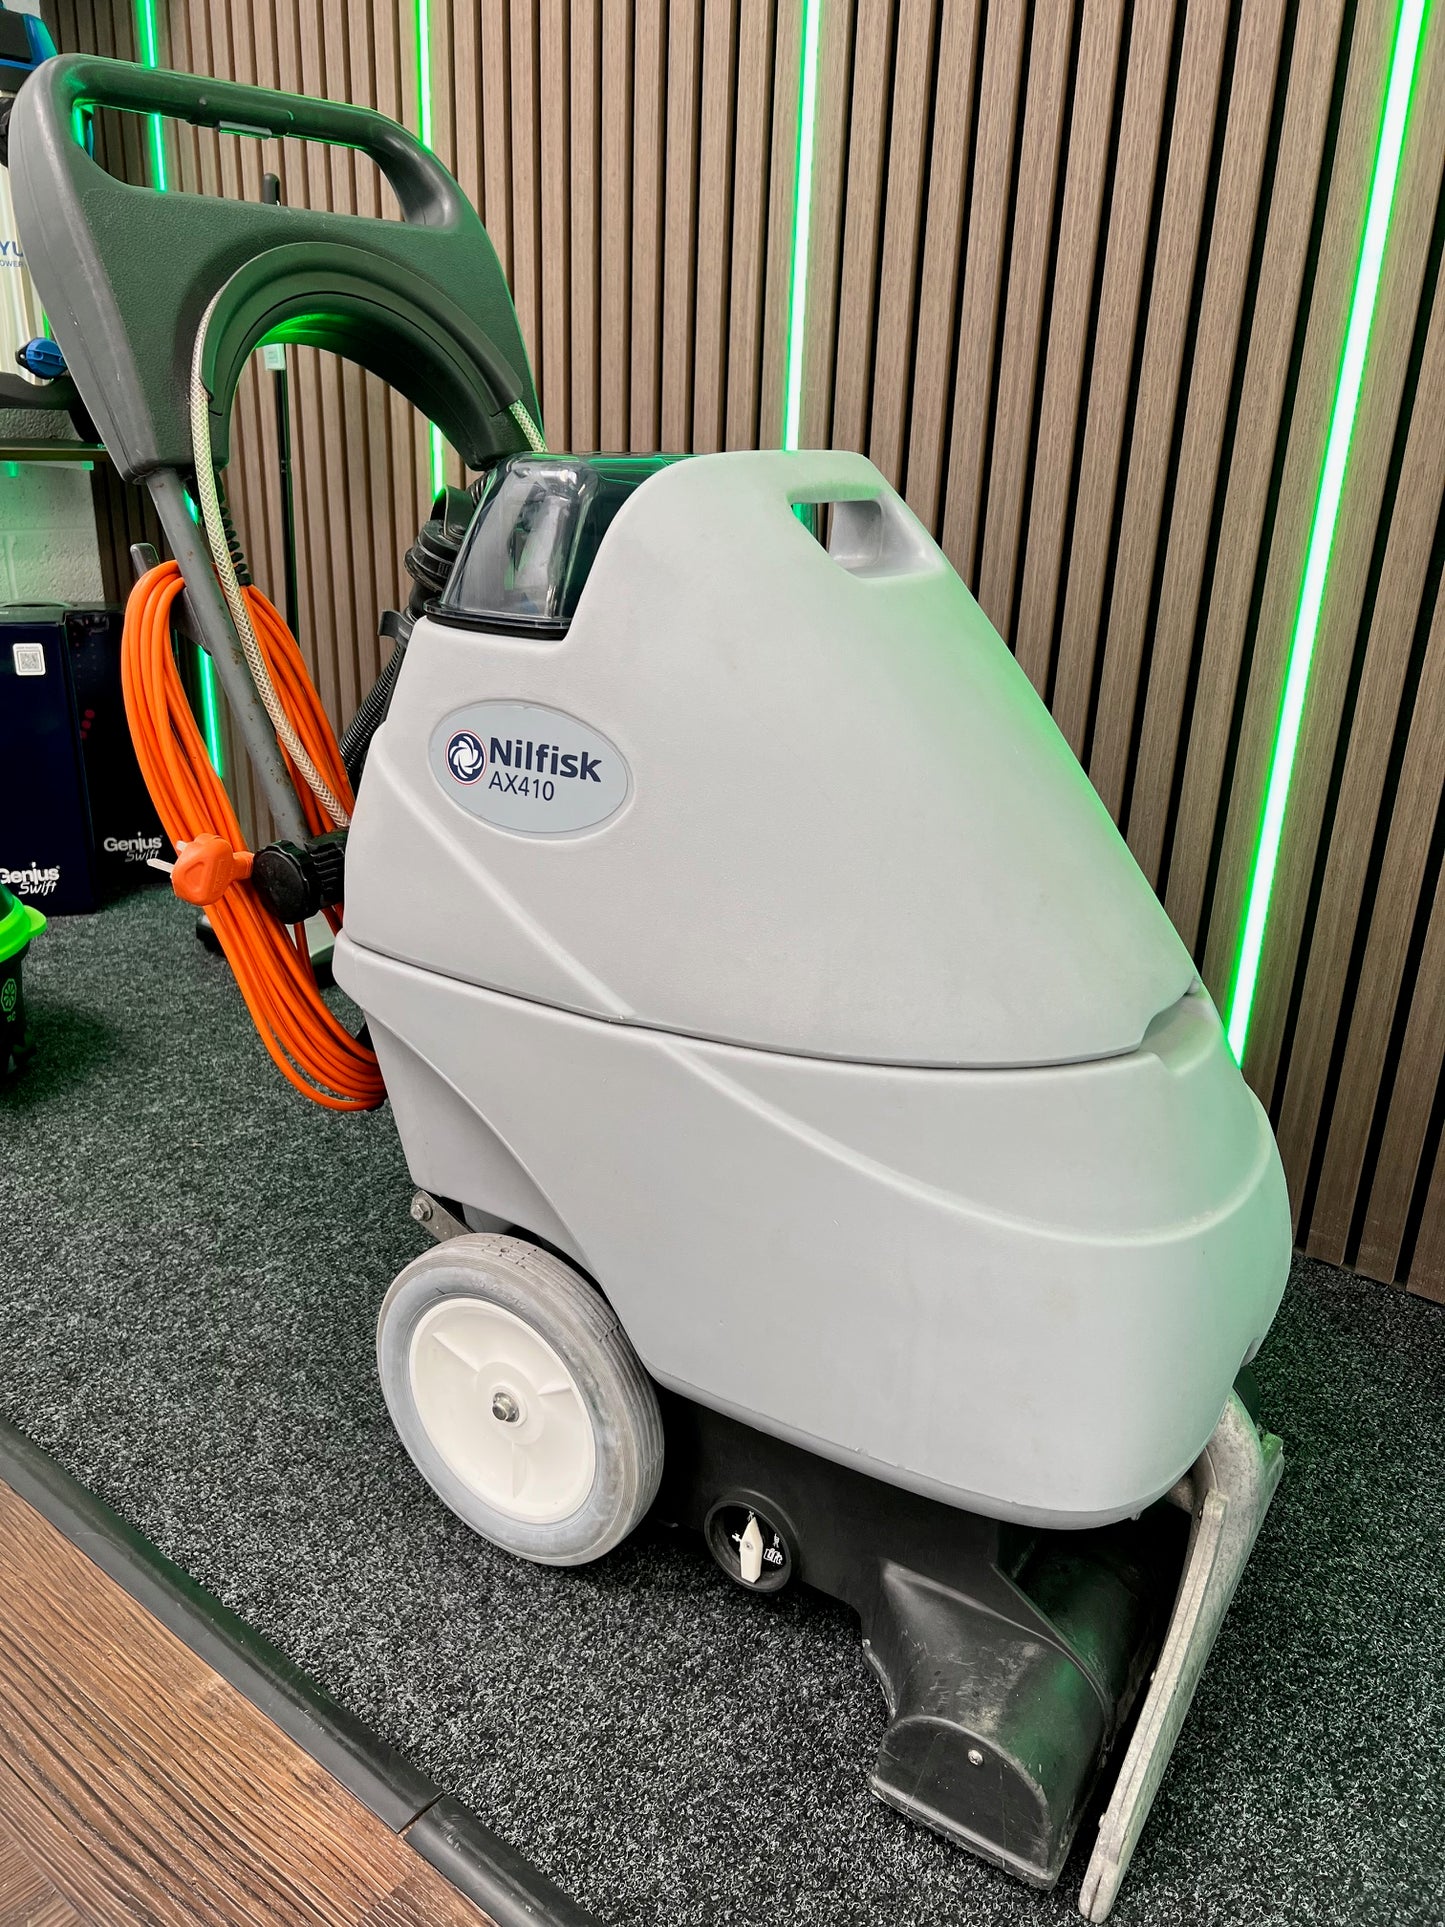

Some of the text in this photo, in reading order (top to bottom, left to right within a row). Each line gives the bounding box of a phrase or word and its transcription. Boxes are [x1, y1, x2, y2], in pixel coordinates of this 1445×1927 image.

[489, 737, 603, 783] Nilfisk
[488, 771, 555, 802] AX410
[103, 831, 163, 853] Genius
[125, 848, 160, 863] Swift
[0, 861, 60, 885] Genius
[18, 881, 57, 897] Swift
